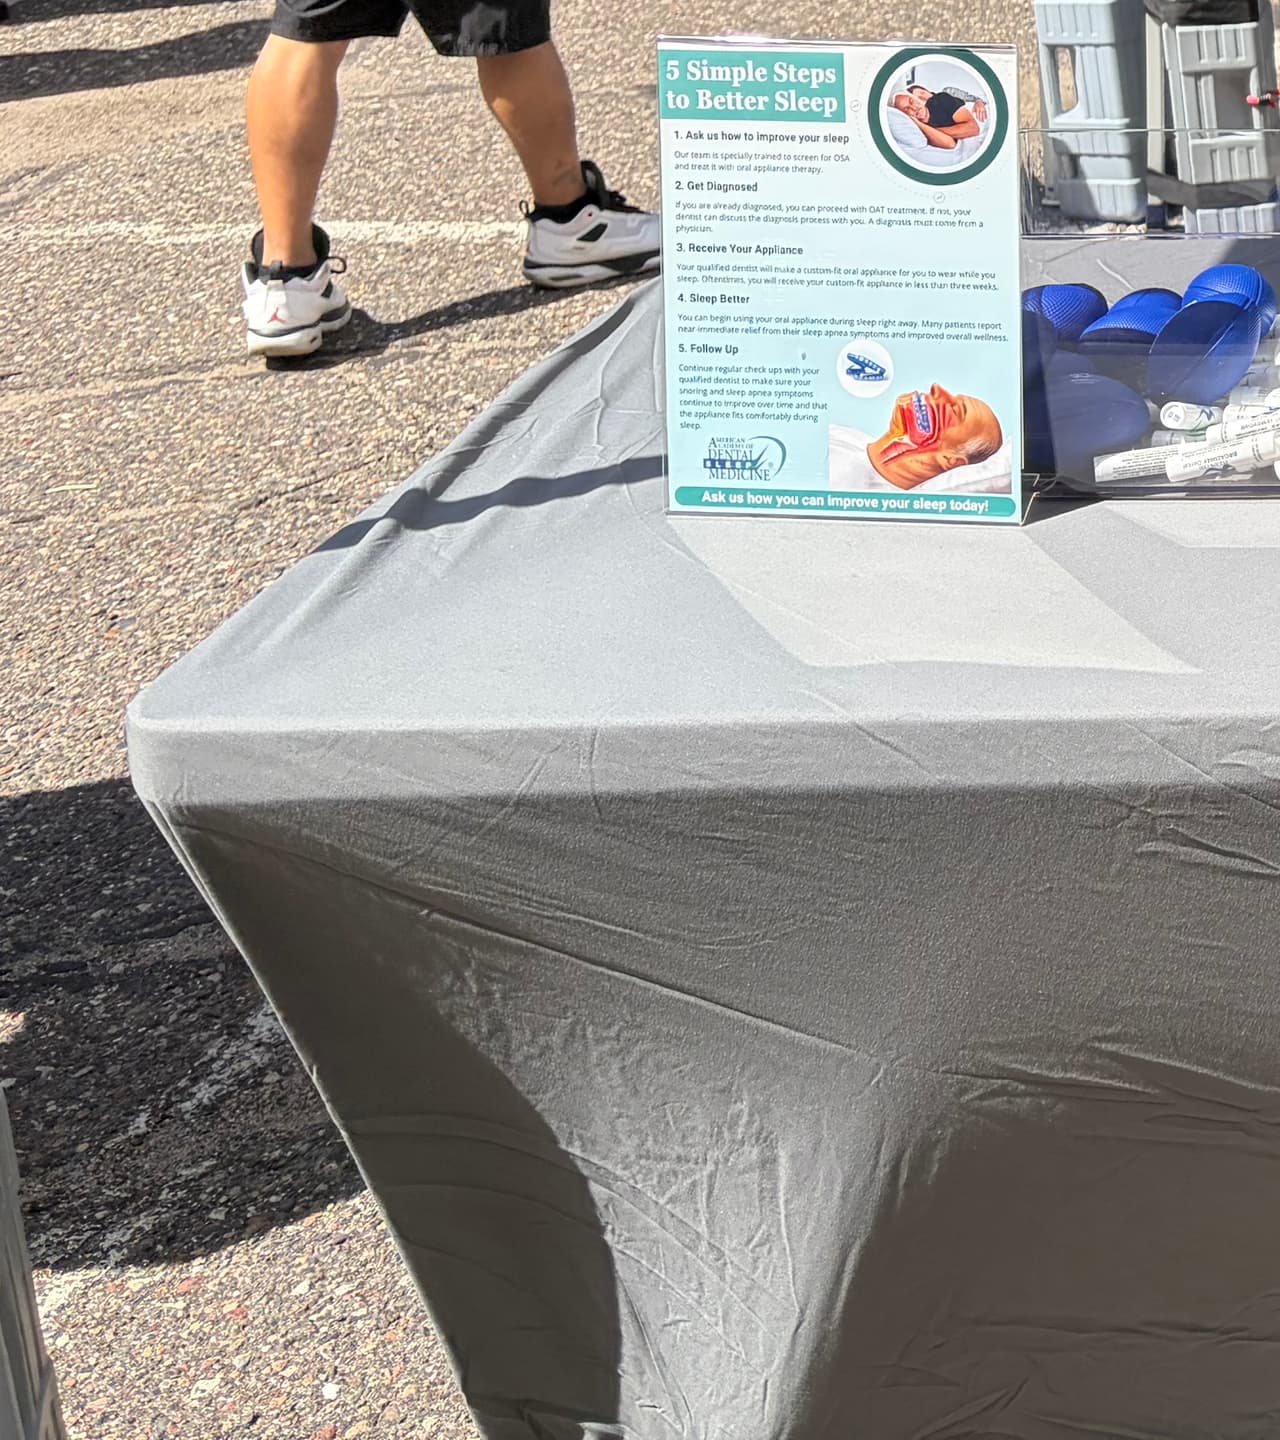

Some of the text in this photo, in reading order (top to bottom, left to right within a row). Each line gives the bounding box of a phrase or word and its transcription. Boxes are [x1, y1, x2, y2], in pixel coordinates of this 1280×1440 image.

[666, 59, 836, 88] 5 Simple Steps
[666, 89, 837, 117] to Better Sleep
[674, 131, 849, 145] 1. Ask us how to improve your sleep
[674, 151, 688, 159] Our
[755, 153, 782, 161] trained
[783, 153, 791, 161] to
[753, 165, 790, 174] appliance
[675, 181, 758, 193] 2. Get Diagnosed
[676, 243, 803, 256] 3. Receive Your Appliance
[677, 294, 750, 305] 4. Sleep Better
[678, 344, 738, 355] 5. Follow Up
[679, 364, 713, 372] Continue
[715, 365, 742, 374] regular
[744, 366, 767, 374] check
[679, 376, 712, 384] qualified
[714, 376, 740, 385] dentist
[742, 377, 750, 385] to
[794, 379, 811, 387] your
[726, 389, 746, 398] sleep
[748, 390, 772, 398] apnea
[774, 391, 813, 399] symptoms
[680, 399, 712, 407] continue
[680, 410, 692, 418] the
[694, 411, 730, 420] appliance
[746, 412, 792, 422] comfortably
[793, 414, 818, 423] during
[708, 449, 754, 459] DENTAL
[709, 469, 771, 481] MEDICINE
[702, 491, 988, 515] Ask us how you can improve your sleep today!
